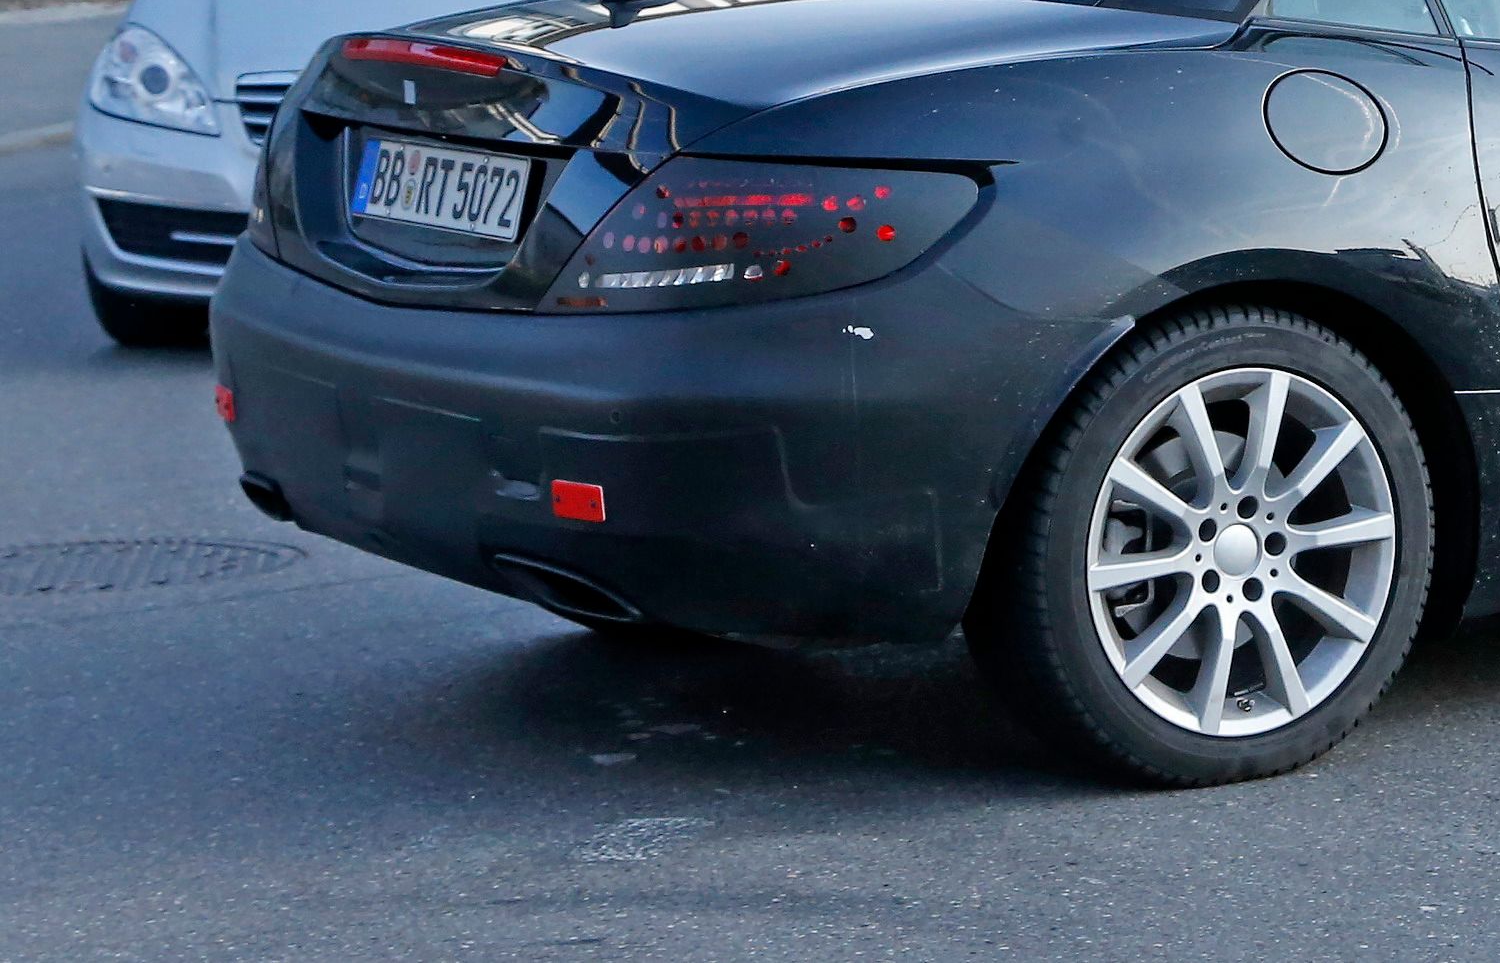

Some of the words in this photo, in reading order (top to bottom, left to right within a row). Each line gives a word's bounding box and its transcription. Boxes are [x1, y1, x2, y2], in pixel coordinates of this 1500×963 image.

[370, 148, 406, 207] BB
[415, 155, 456, 217] RT
[452, 161, 521, 229] 5072
